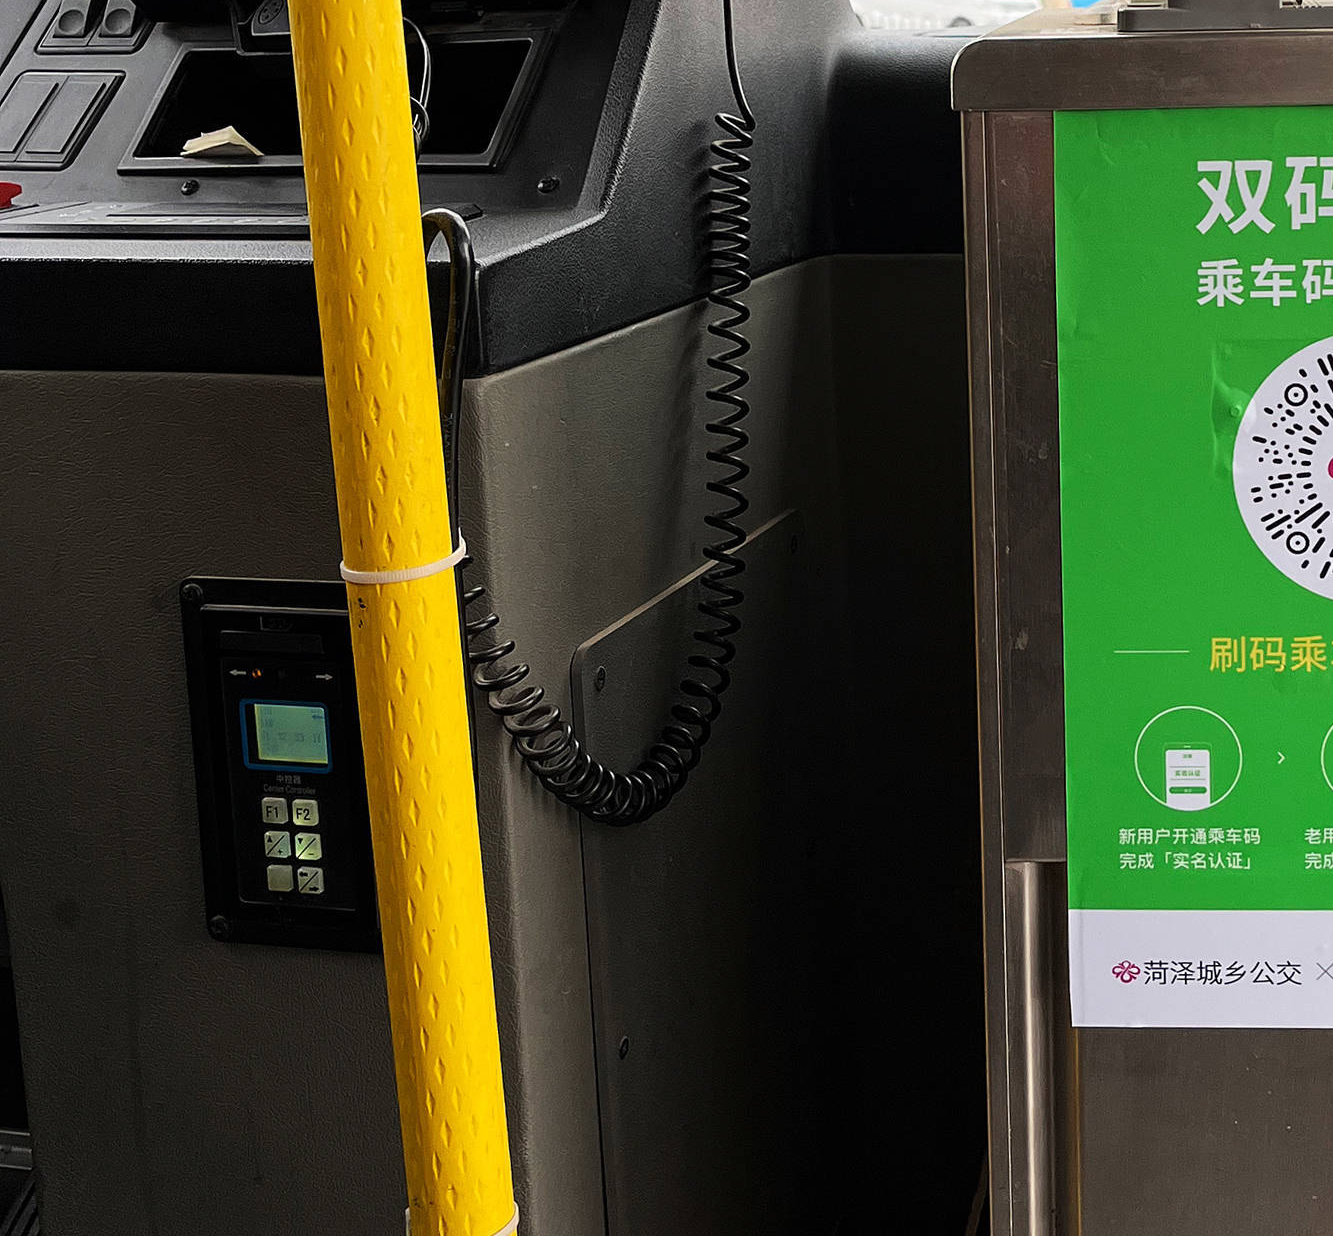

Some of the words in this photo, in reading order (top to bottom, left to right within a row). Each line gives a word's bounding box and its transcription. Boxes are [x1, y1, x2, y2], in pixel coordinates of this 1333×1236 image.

[266, 805, 279, 819] F1
[295, 807, 311, 821] F2
[1118, 826, 1261, 847] 新用户开通乘车码
[1143, 961, 1303, 987] 菏泽城乡公交
